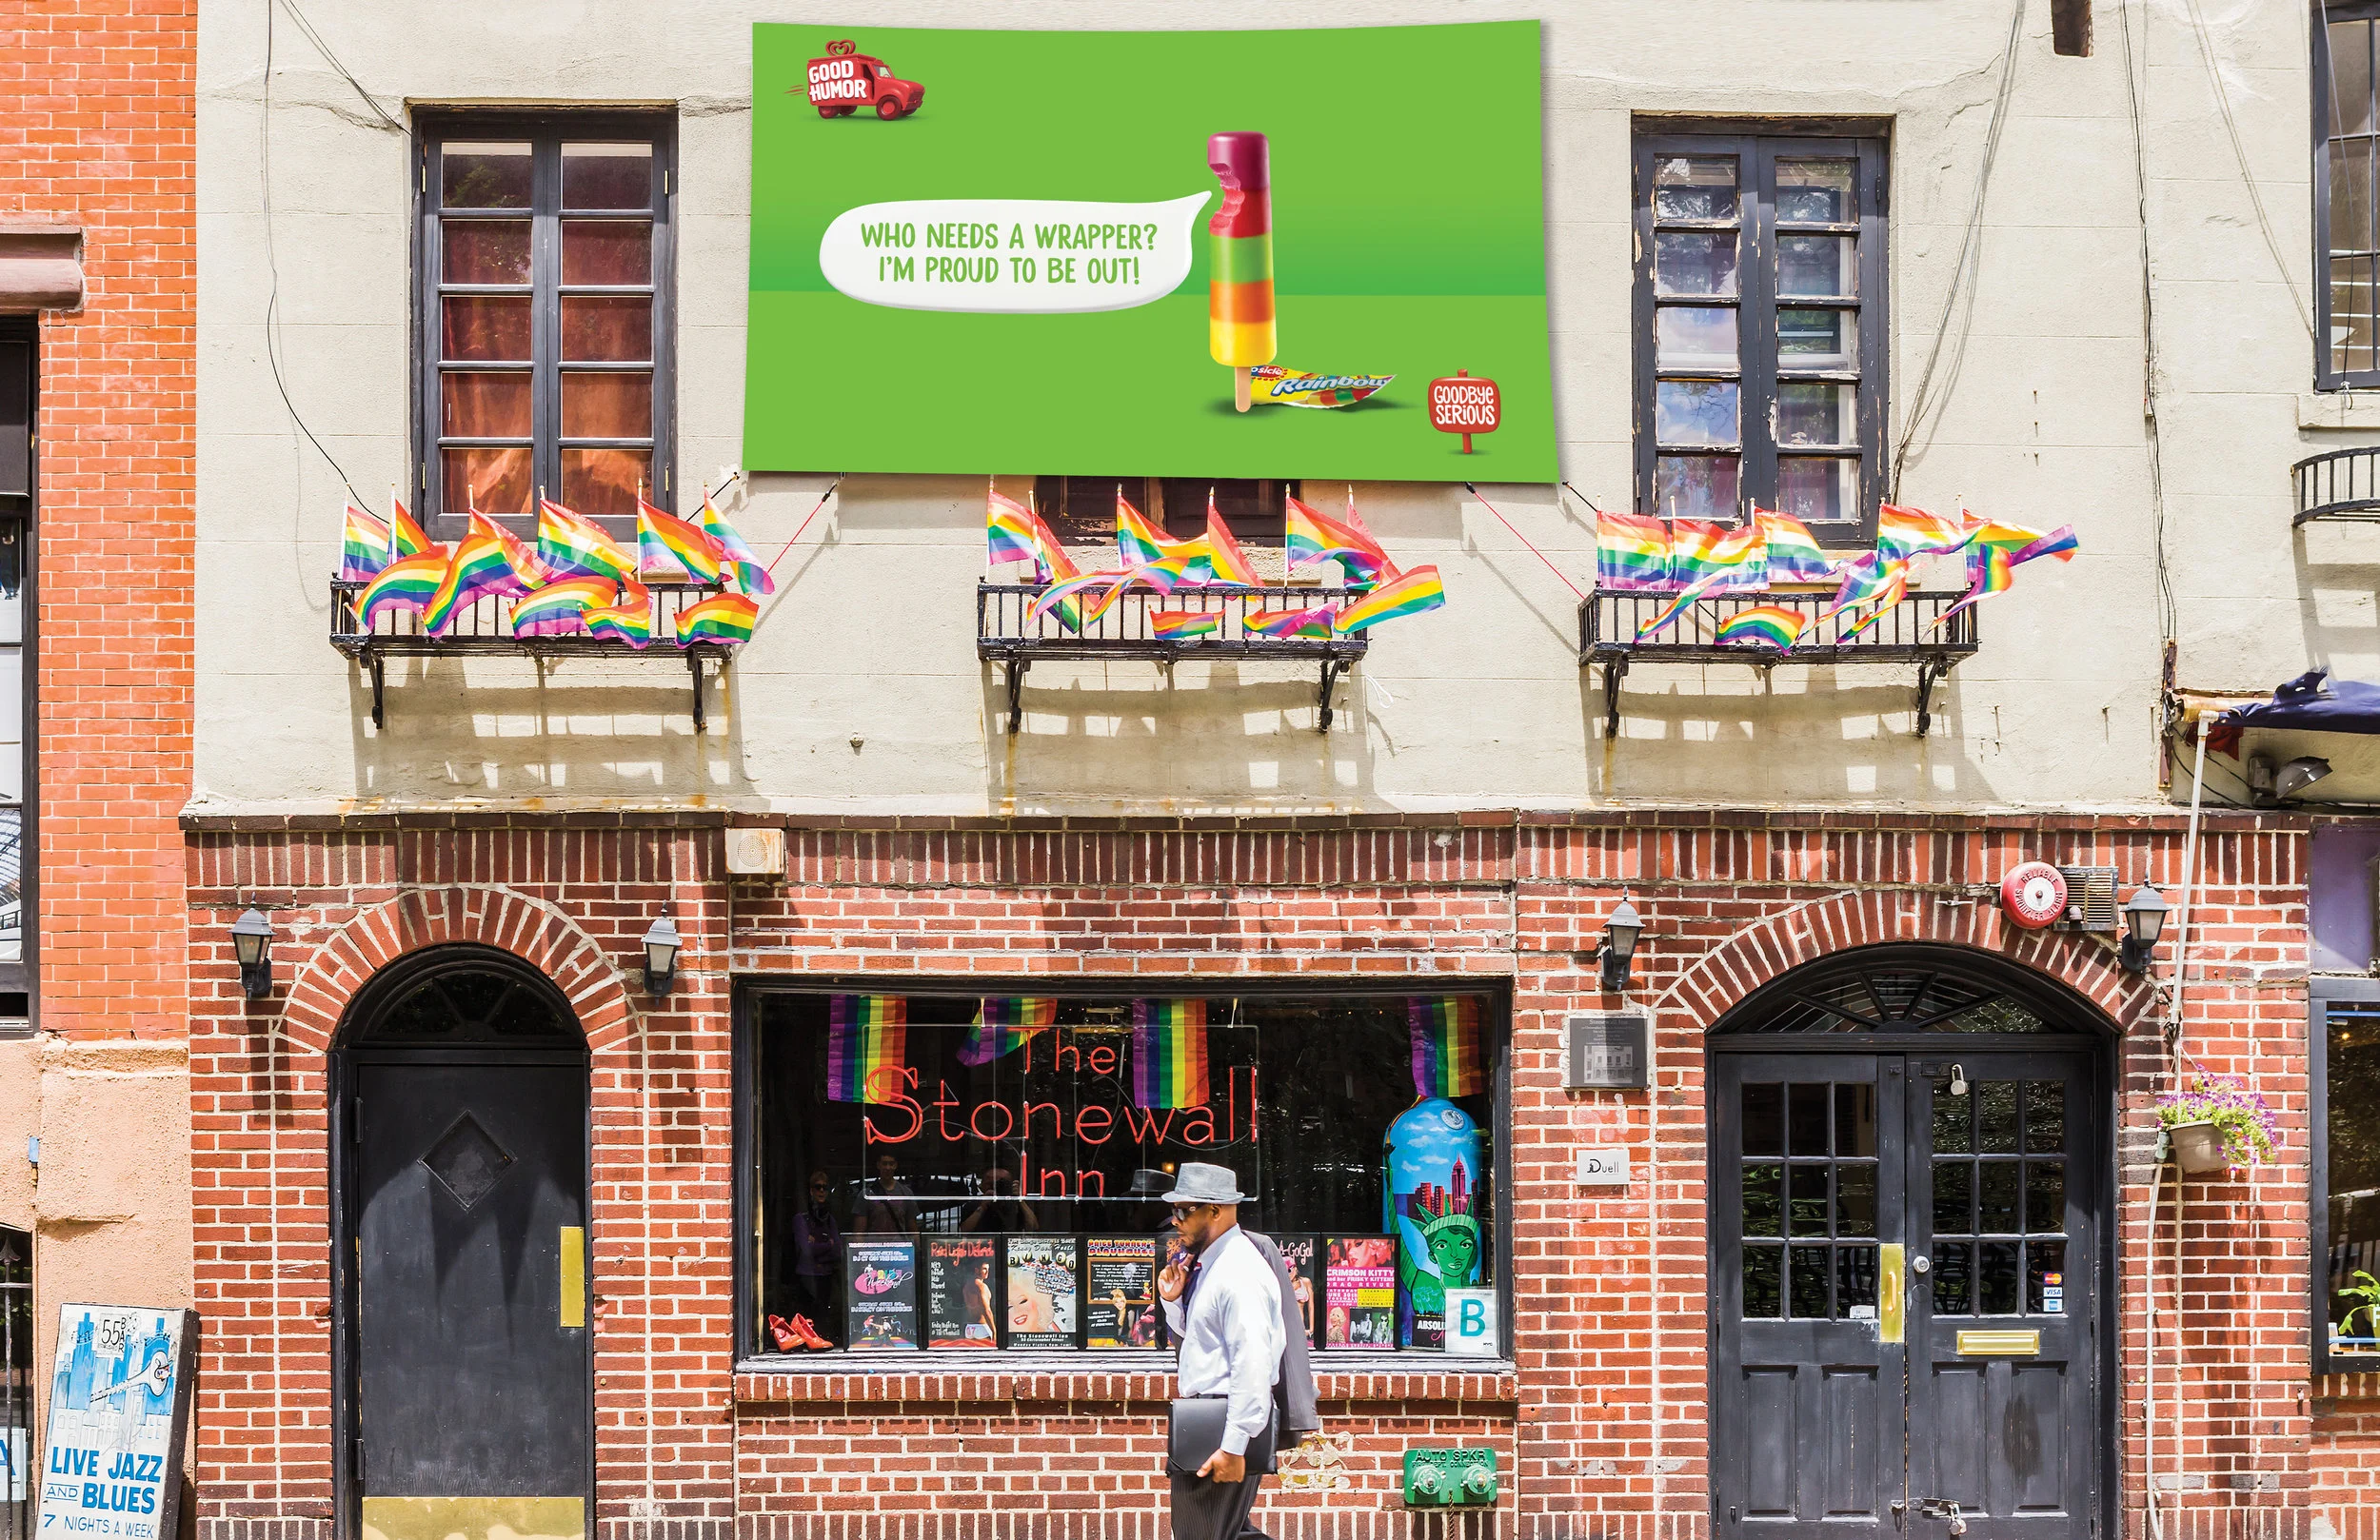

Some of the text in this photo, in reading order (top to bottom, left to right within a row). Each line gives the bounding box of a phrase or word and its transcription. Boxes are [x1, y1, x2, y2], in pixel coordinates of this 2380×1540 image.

[809, 60, 854, 84] GOOD
[809, 79, 867, 102] HUMOR
[861, 222, 1159, 250] WHO NEEDS A WRAPPER?
[879, 256, 1140, 285] I'M PROUD TO BE OUT!
[1270, 376, 1387, 397] Rainbow
[2021, 868, 2058, 885] RELIABLE
[1006, 1027, 1116, 1076] The
[864, 1065, 1258, 1145] Stonewall
[1021, 1150, 1105, 1197] Inn
[1460, 1298, 1486, 1337] B
[101, 1319, 121, 1346] 55
[50, 1447, 163, 1483] LIVE JAZZ
[1415, 1450, 1486, 1462] AUTO SPKR
[46, 1482, 155, 1514] AND BLUES
[44, 1513, 154, 1539] 7 NIGHTS A WEEK
